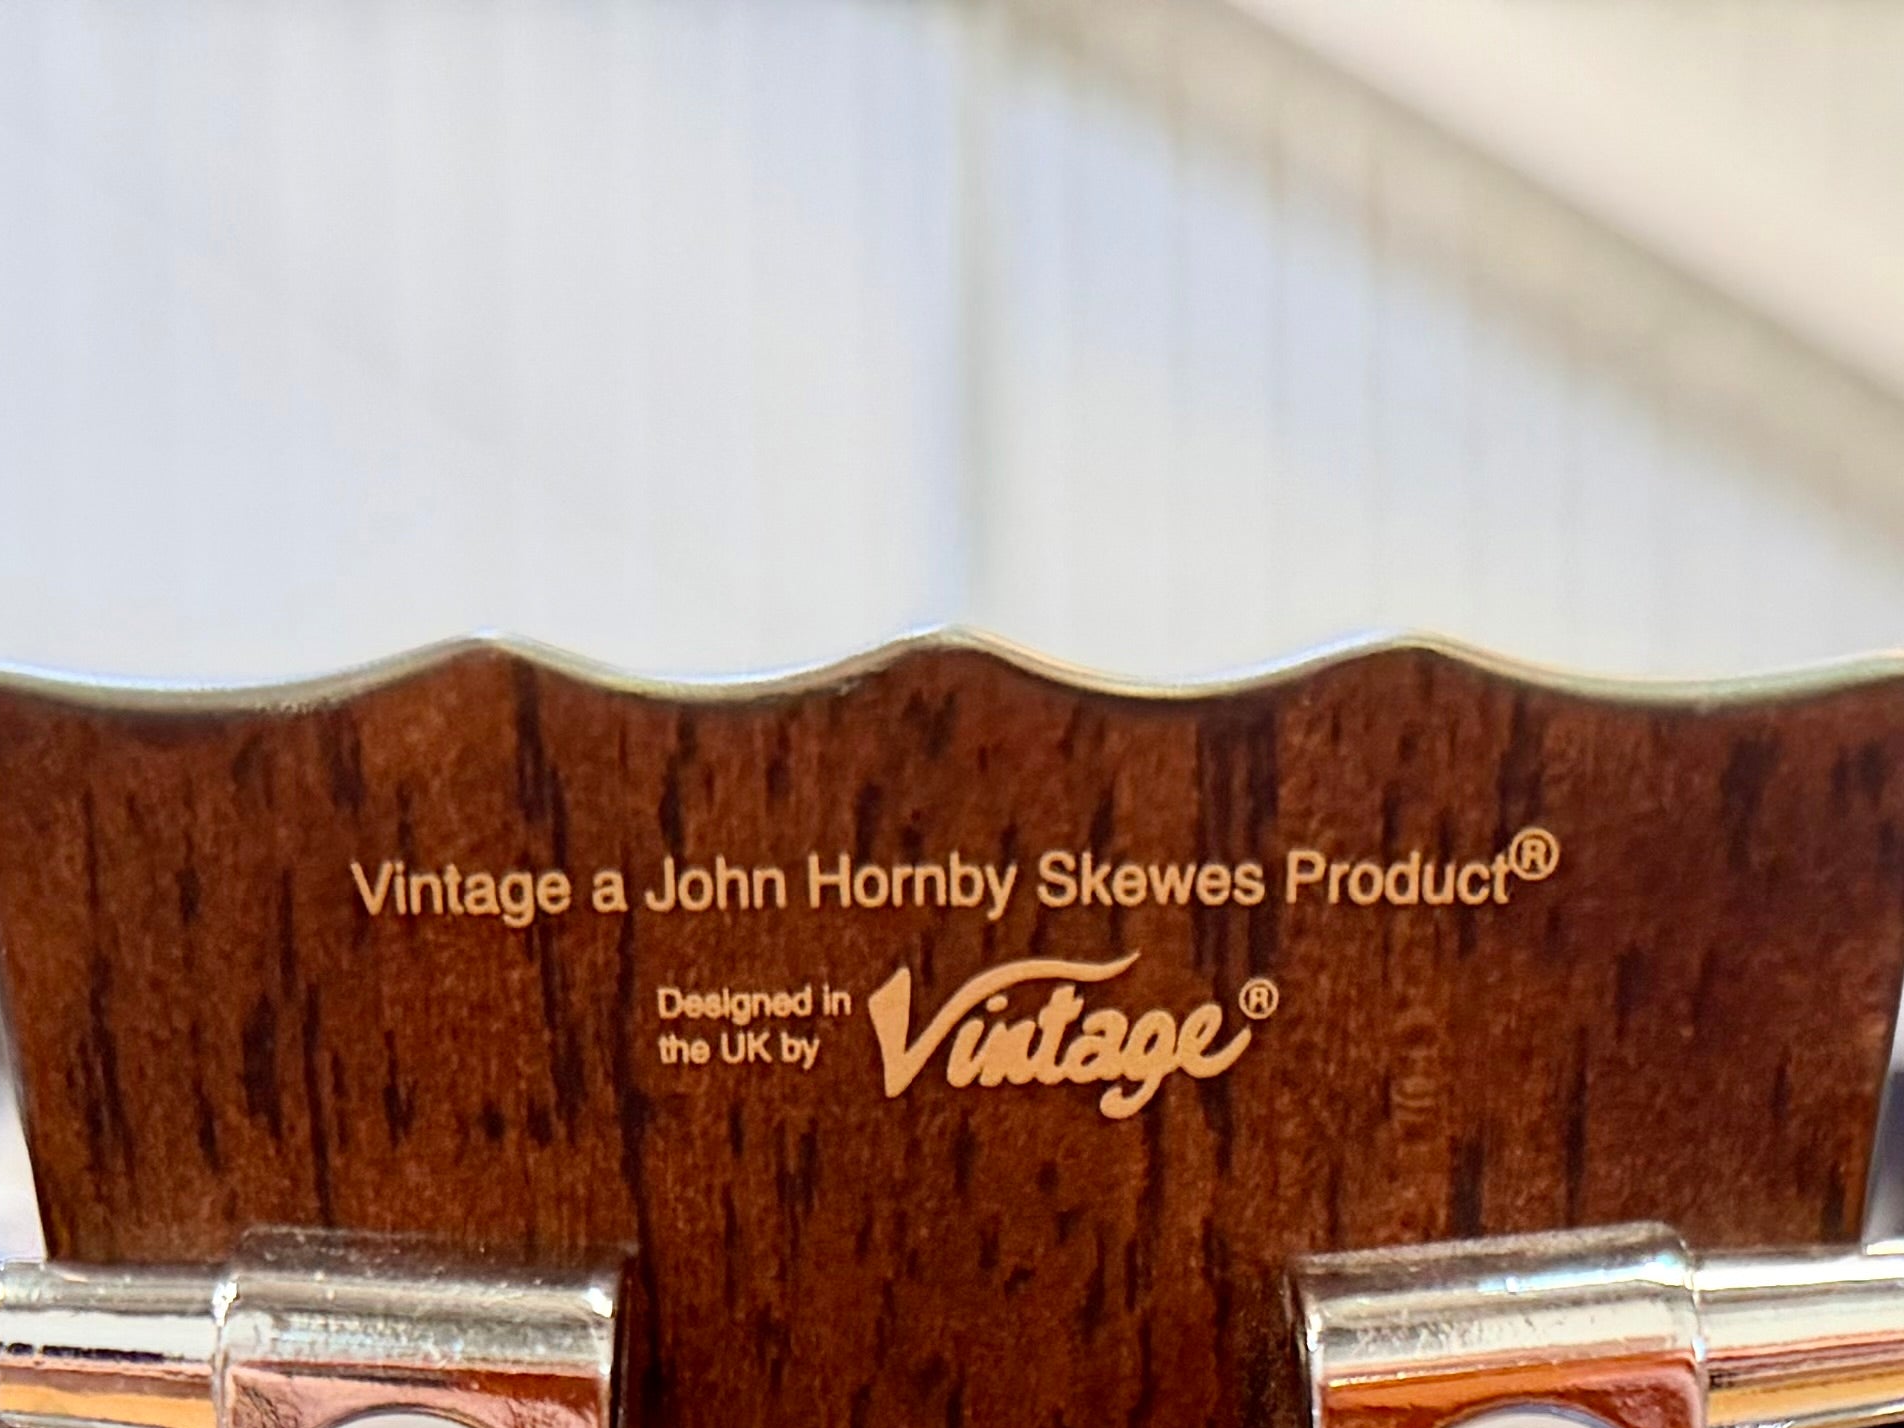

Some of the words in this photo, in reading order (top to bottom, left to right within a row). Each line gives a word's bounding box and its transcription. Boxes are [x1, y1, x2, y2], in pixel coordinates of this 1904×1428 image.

[350, 861, 571, 928] Vintage
[592, 870, 628, 912] a
[644, 855, 787, 911] John
[807, 850, 1018, 921] Hornby
[1036, 850, 1266, 907] Skewes
[656, 984, 813, 1026] Designed
[821, 983, 852, 1016] in
[657, 1032, 711, 1064] the
[720, 1031, 773, 1064] UK
[779, 1030, 821, 1070] by
